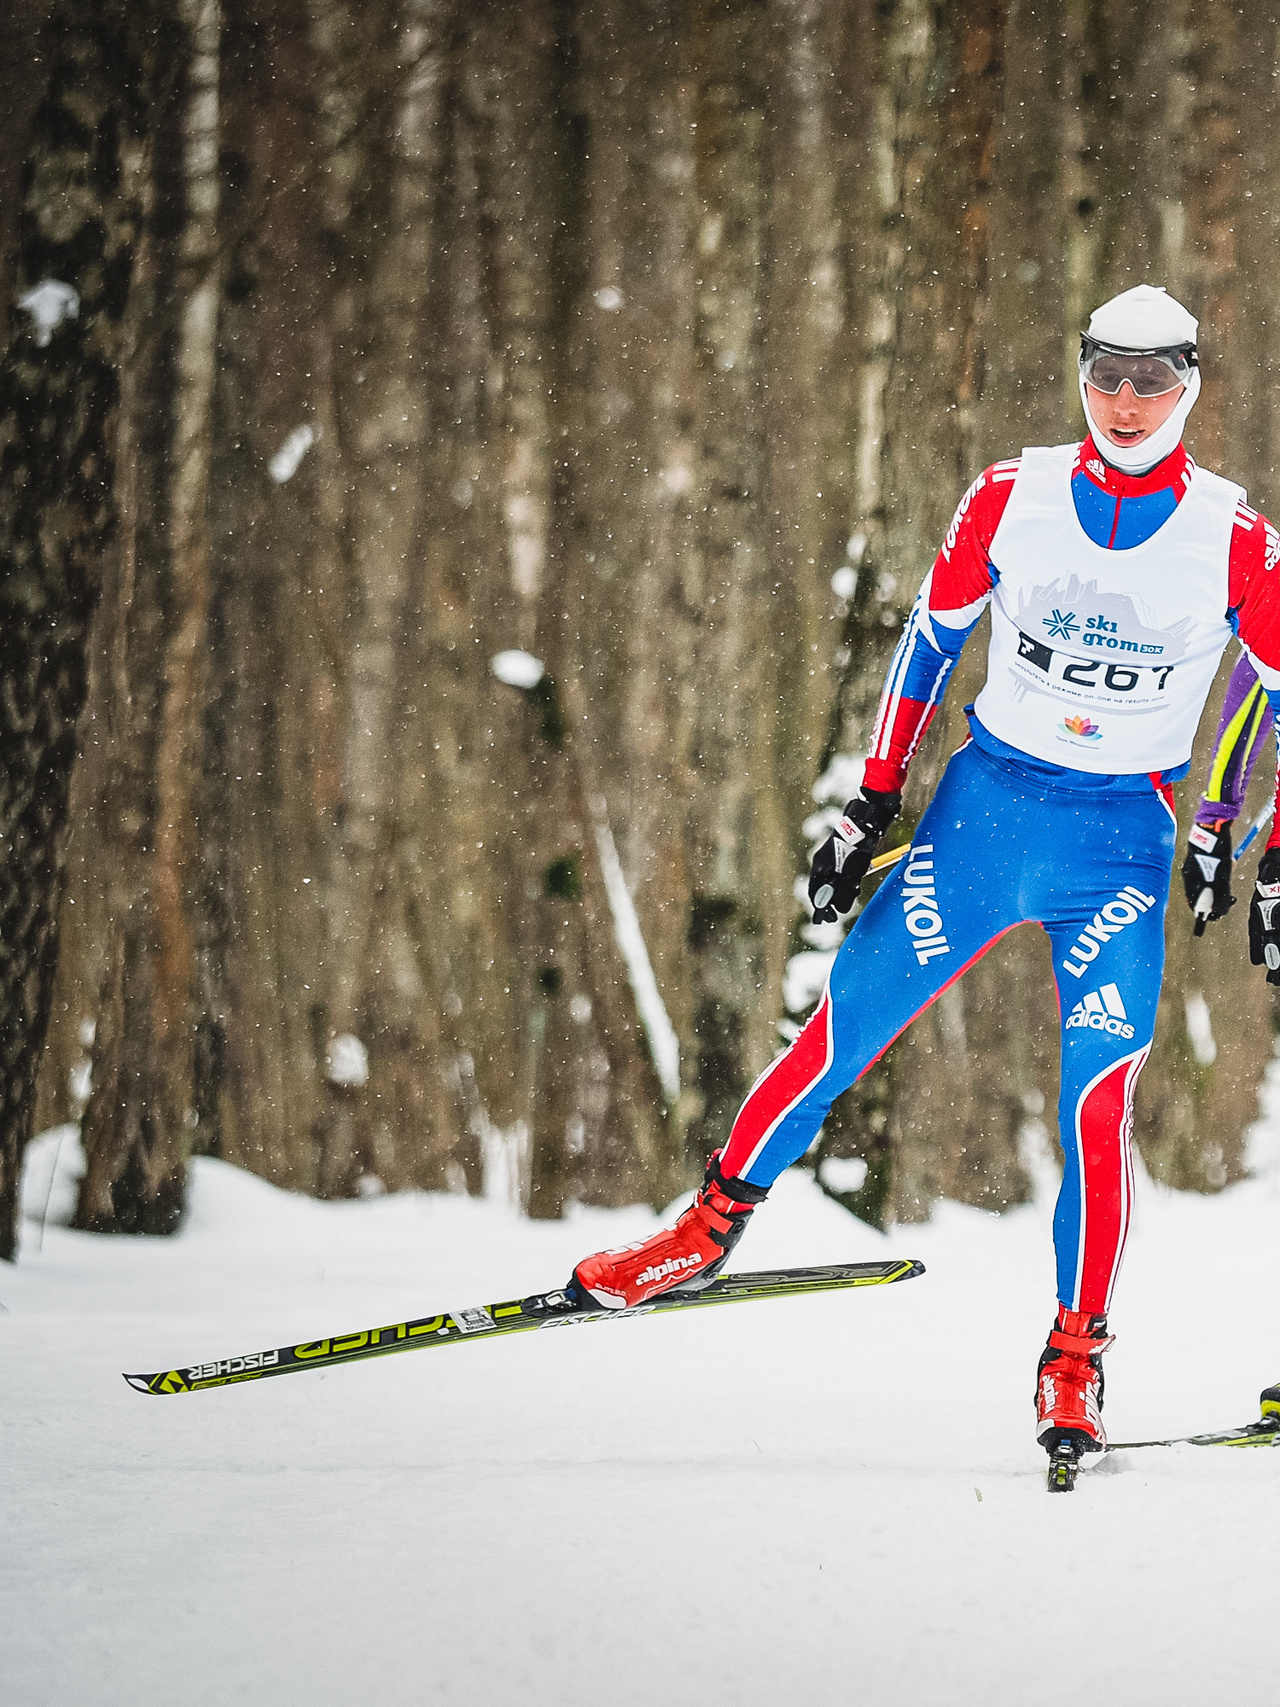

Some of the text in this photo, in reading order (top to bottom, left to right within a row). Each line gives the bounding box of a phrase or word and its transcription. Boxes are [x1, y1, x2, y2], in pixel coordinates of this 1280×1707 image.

[1085, 615, 1118, 633] ski
[1083, 632, 1139, 652] grom
[900, 844, 950, 966] LUKOIL
[1062, 885, 1156, 978] LUKOIL
[1065, 1010, 1135, 1039] adidas
[635, 1252, 702, 1286] alpina
[187, 1350, 279, 1380] FISCHER
